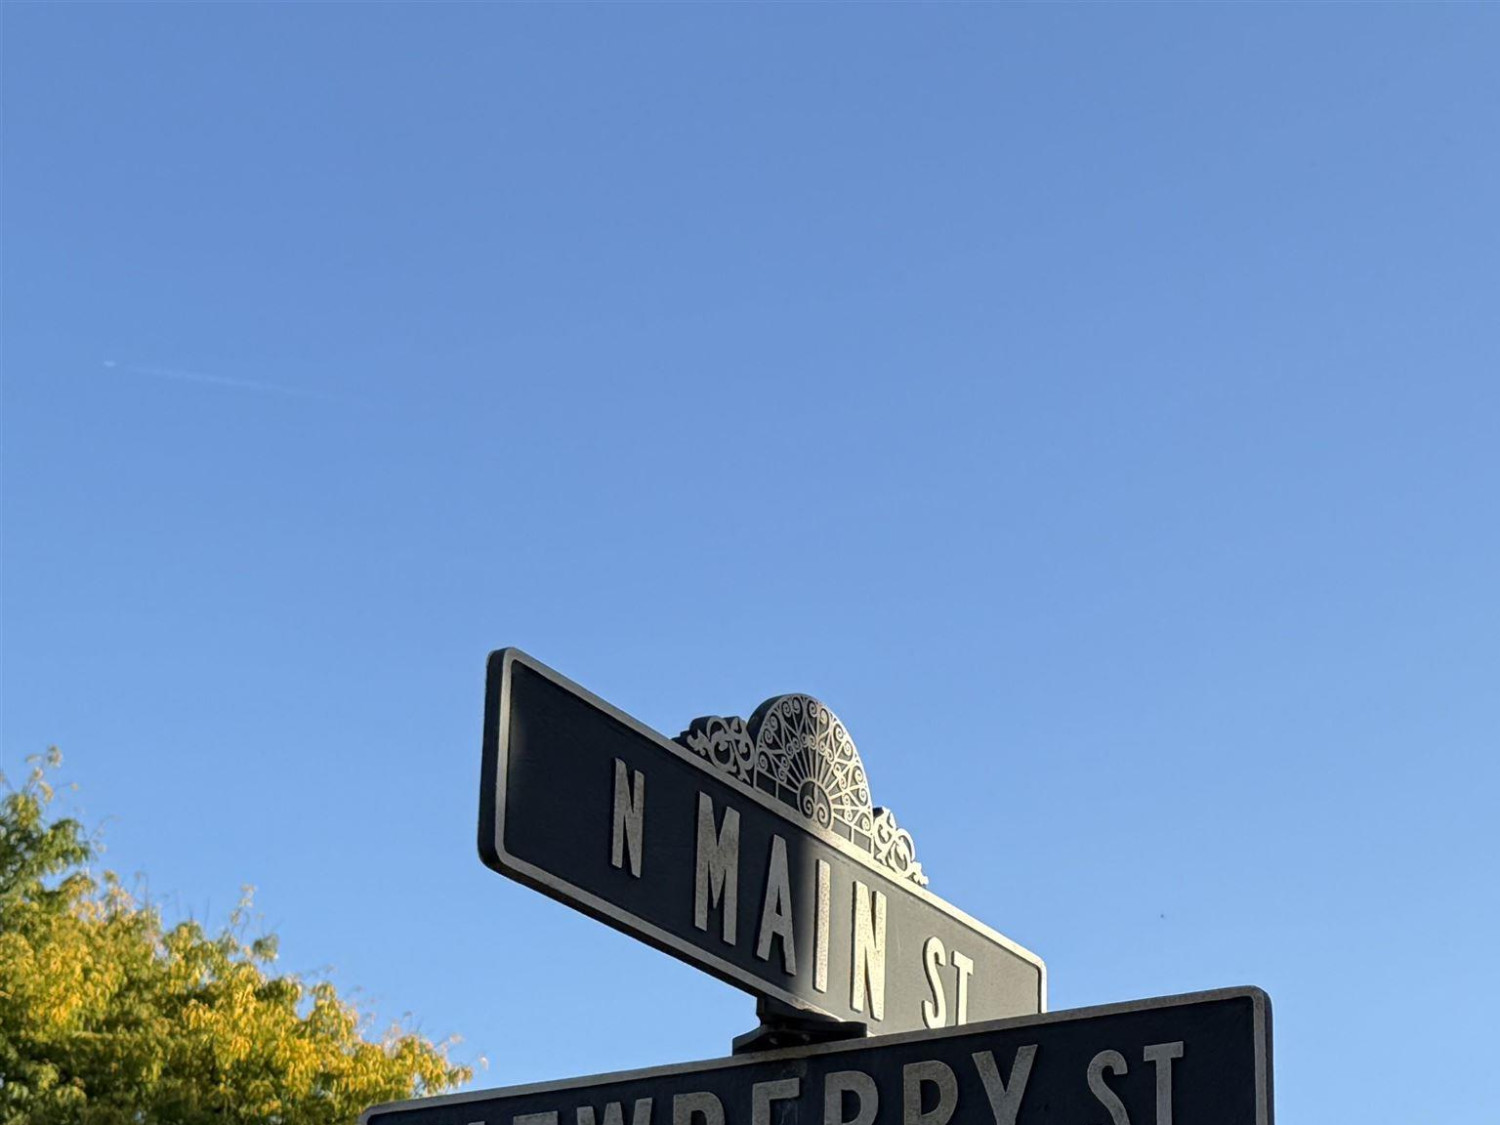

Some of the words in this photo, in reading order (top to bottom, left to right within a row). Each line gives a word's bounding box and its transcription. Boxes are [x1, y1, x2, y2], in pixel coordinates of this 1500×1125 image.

[611, 757, 645, 878] N
[694, 791, 888, 1021] MAIN
[922, 936, 974, 1027] ST
